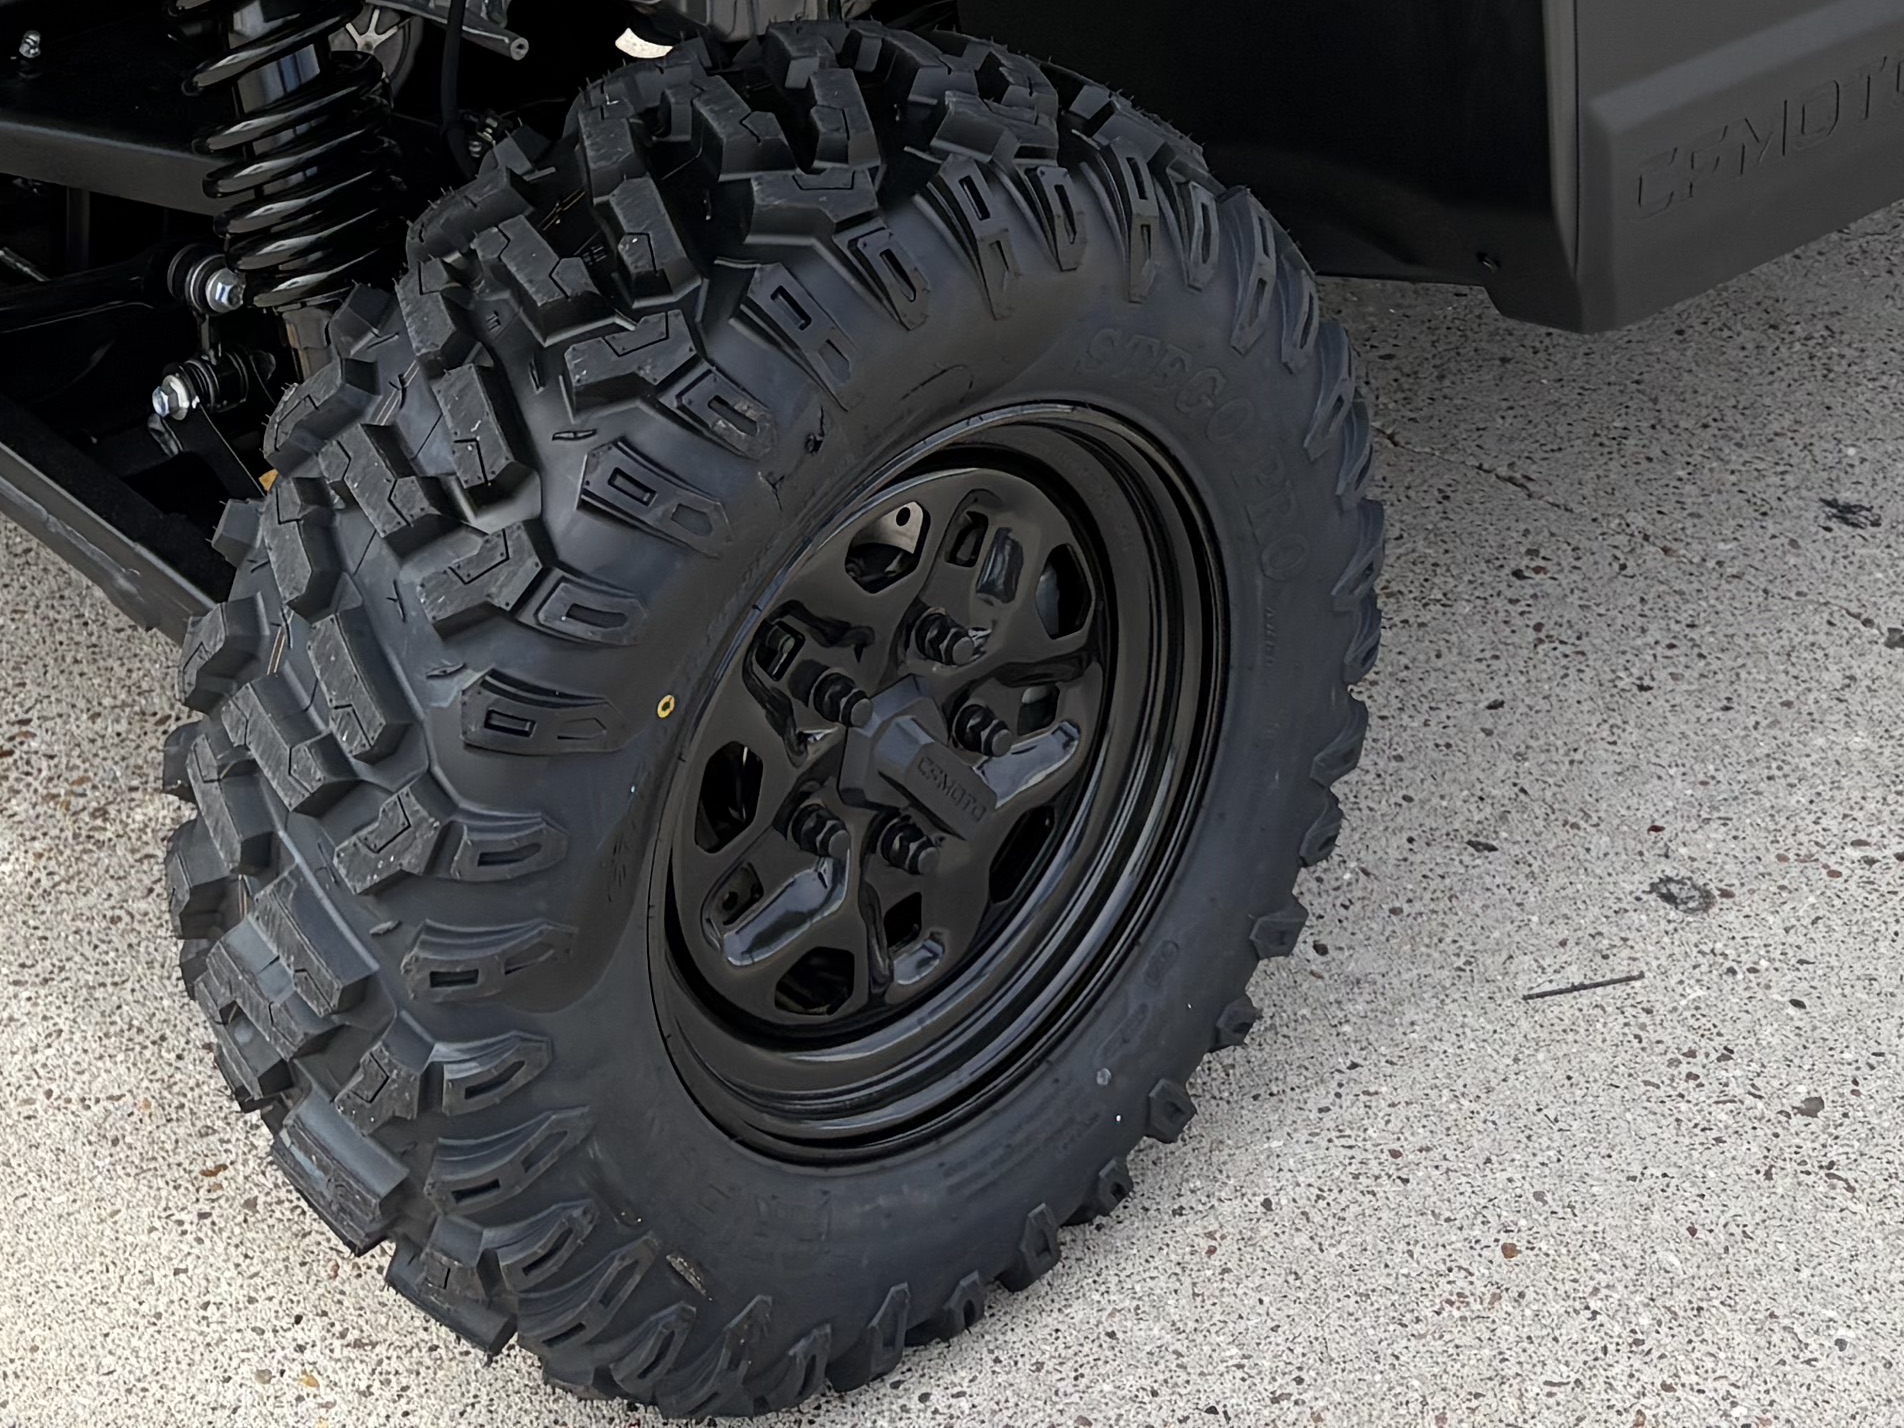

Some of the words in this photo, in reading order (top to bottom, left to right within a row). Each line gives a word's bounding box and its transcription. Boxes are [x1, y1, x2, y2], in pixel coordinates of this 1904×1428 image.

[1075, 327, 1256, 444] STEGO
[1233, 444, 1310, 582] PRO
[916, 755, 988, 823] CFMOTO
